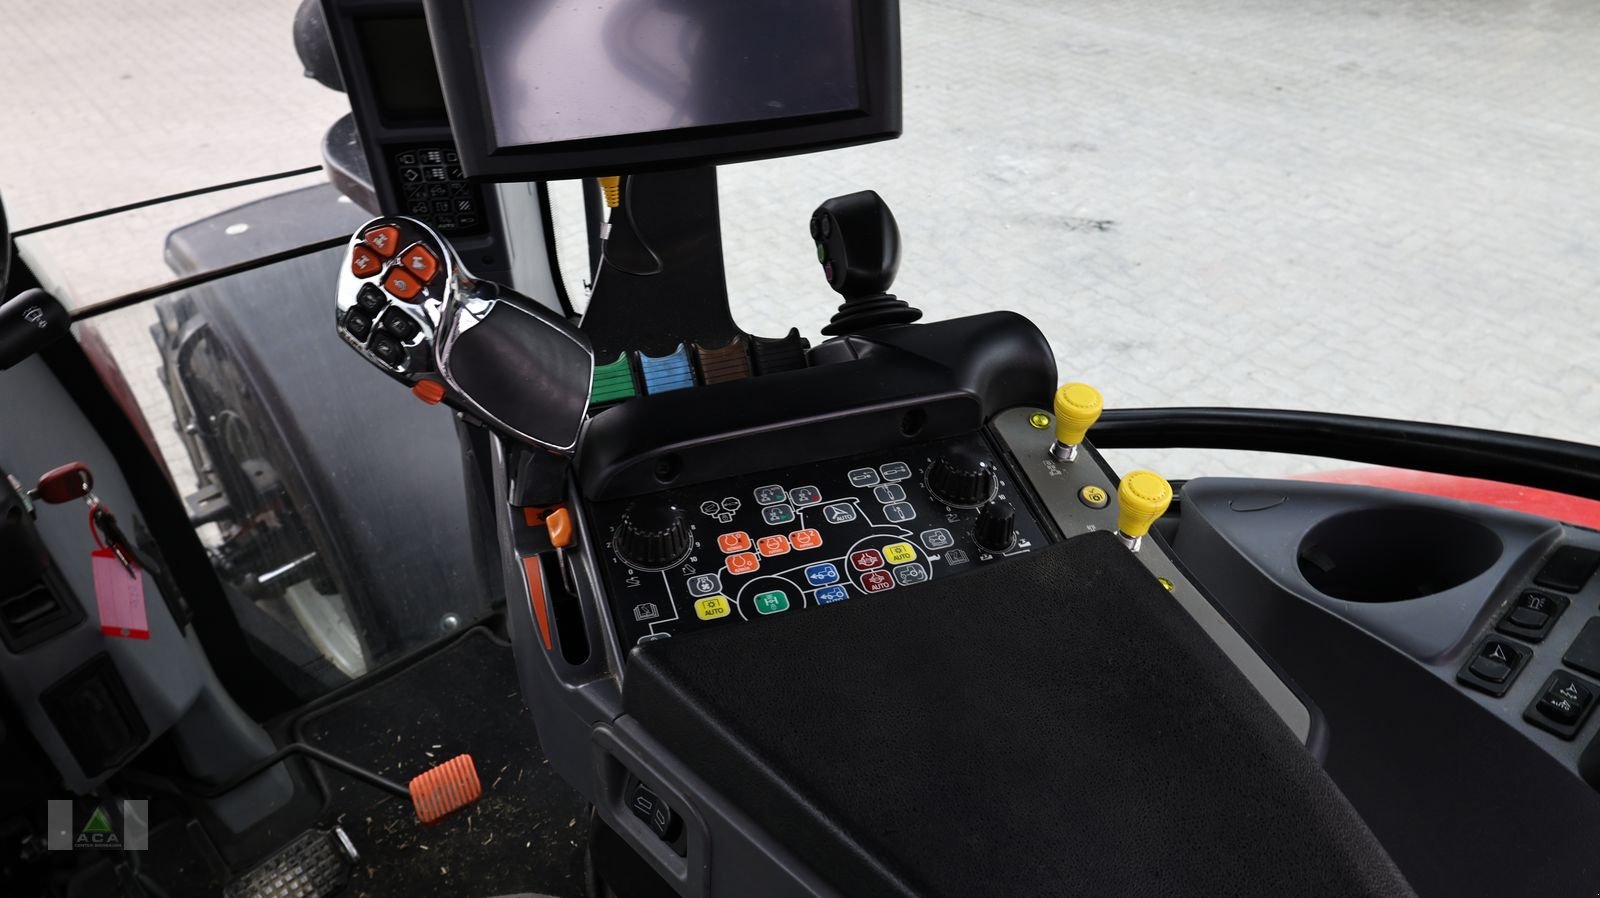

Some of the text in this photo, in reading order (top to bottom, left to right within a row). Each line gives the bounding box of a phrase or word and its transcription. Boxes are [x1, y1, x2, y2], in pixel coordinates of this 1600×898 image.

[893, 553, 911, 561] AUTO
[871, 582, 890, 591] AUTO
[704, 607, 724, 616] AUTO
